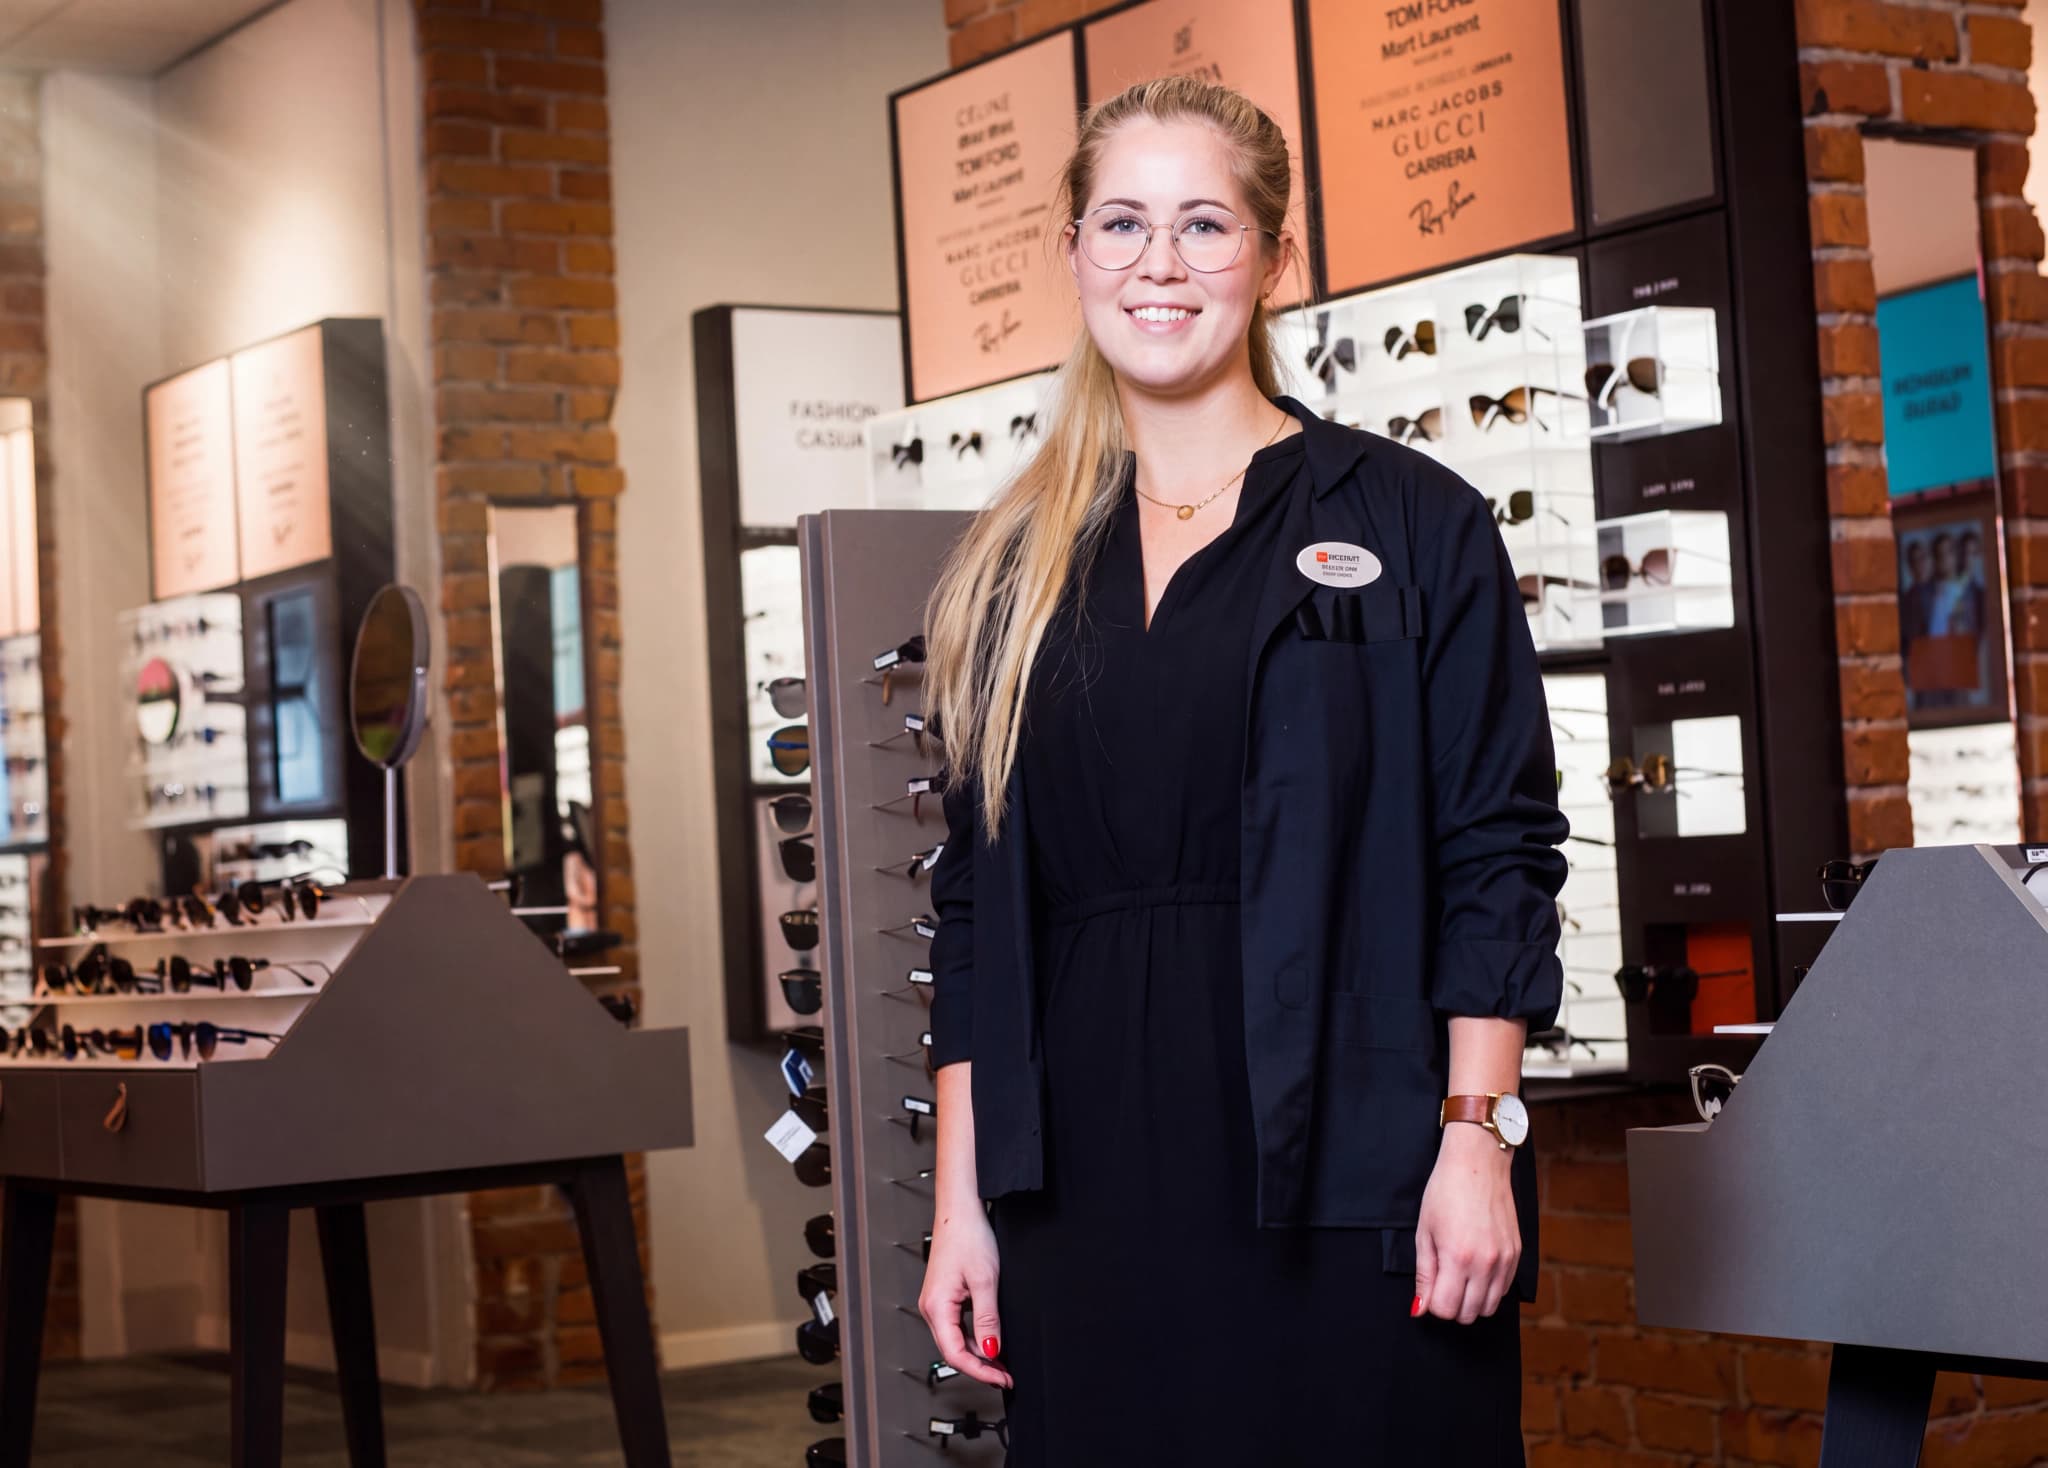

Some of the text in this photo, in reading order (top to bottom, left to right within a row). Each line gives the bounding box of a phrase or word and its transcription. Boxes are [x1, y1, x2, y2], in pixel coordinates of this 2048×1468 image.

[1385, 0, 1422, 30] TOM
[1381, 36, 1416, 60] Mart
[1419, 13, 1481, 48] Laurent
[1372, 105, 1421, 132] MARC
[1428, 79, 1503, 116] JACOBS
[1392, 109, 1486, 158] GUCCI
[1404, 145, 1477, 180] CARRERA
[959, 248, 1030, 288] GUCCI
[794, 426, 864, 450] CASUA
